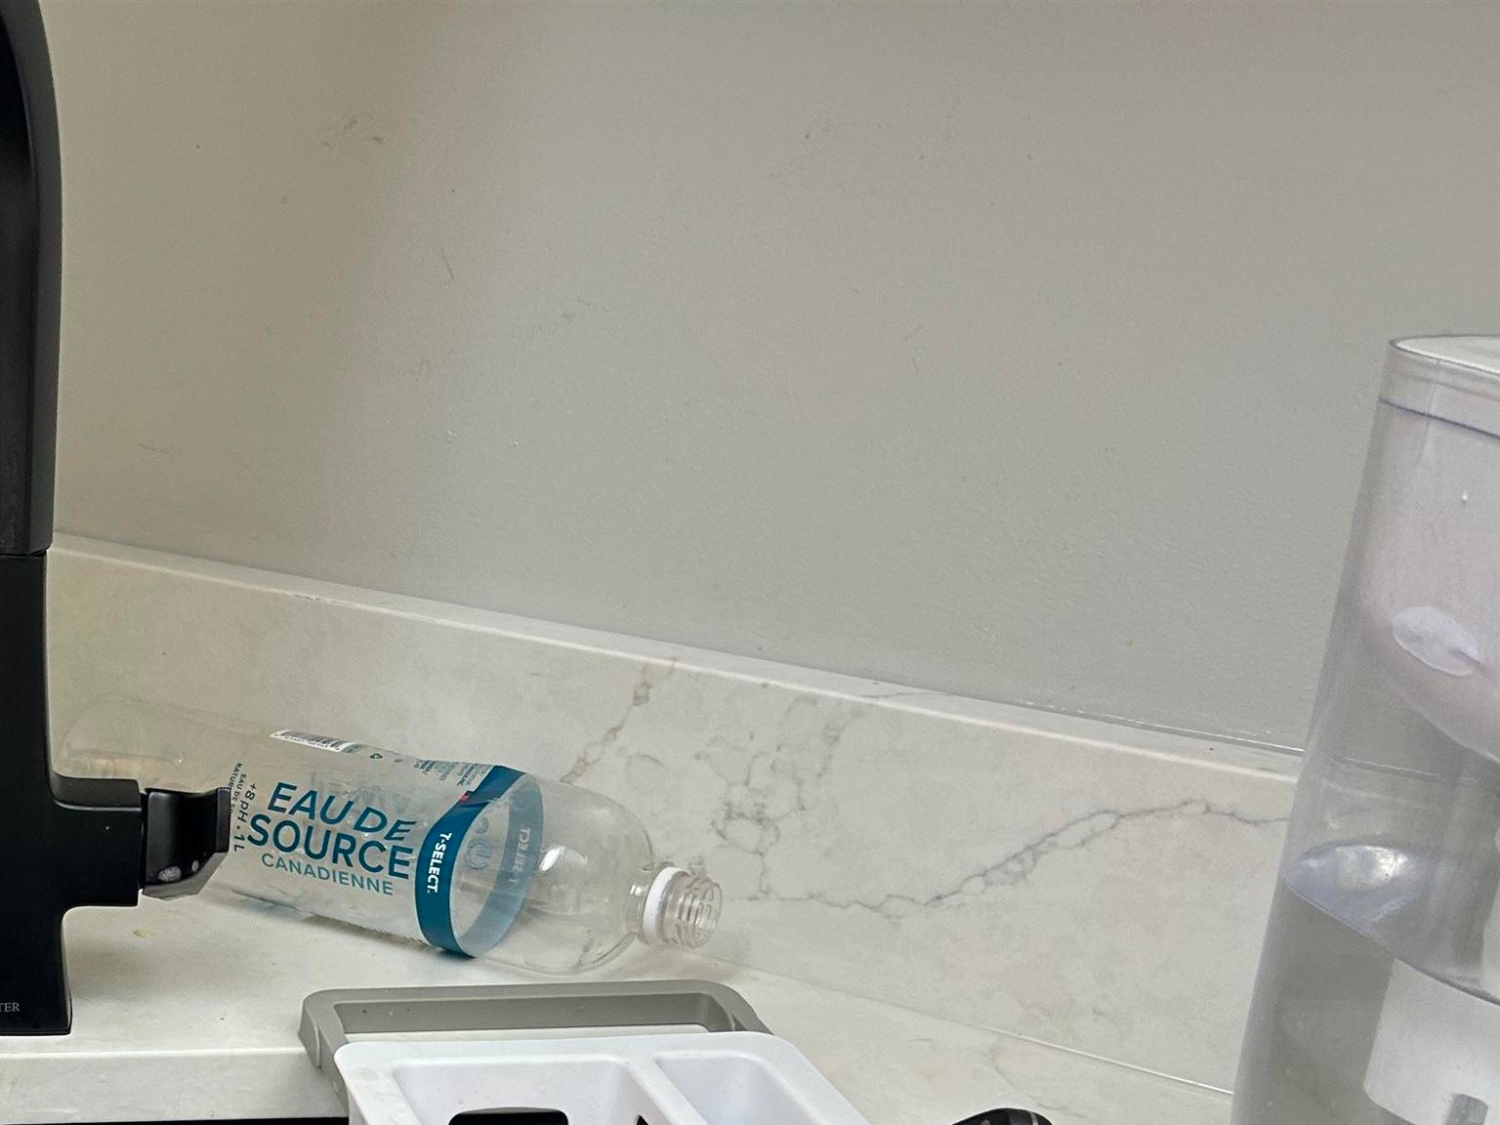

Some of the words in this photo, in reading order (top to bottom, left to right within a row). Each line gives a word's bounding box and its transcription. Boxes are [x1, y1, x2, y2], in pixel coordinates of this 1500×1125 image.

[267, 781, 355, 825] EAU
[353, 806, 417, 841] DE
[247, 813, 414, 880] SOURCE
[261, 852, 394, 896] CANADIENNE
